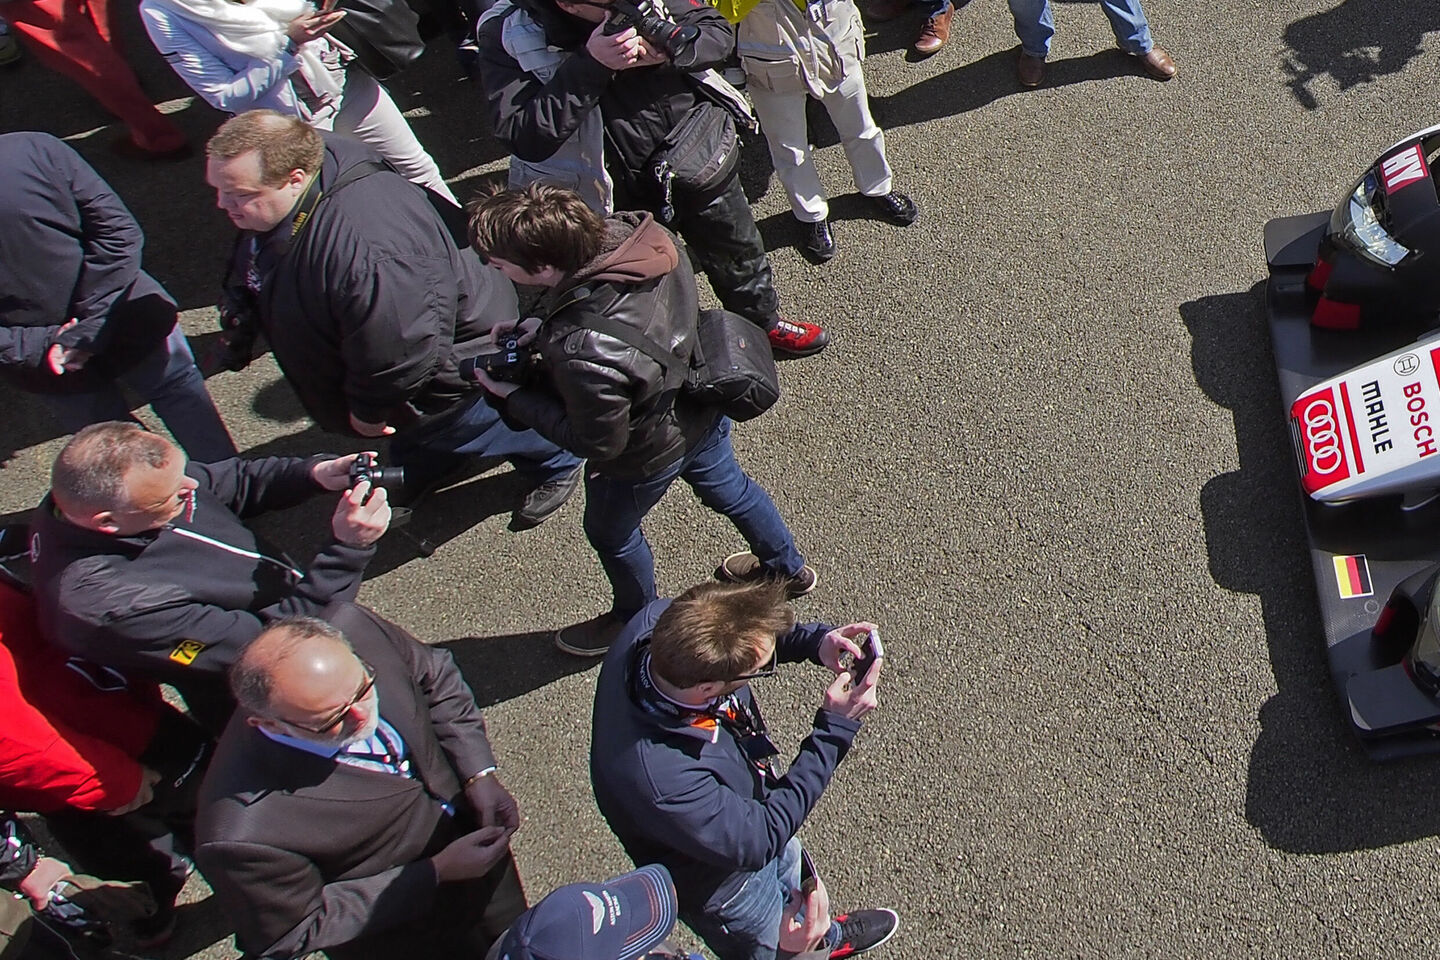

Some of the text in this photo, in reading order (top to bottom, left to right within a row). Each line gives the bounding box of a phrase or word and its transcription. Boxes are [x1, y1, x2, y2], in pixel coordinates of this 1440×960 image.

[1382, 147, 1424, 188] HY
[1361, 379, 1393, 455] MAHLE
[1403, 381, 1438, 458] BOSCH
